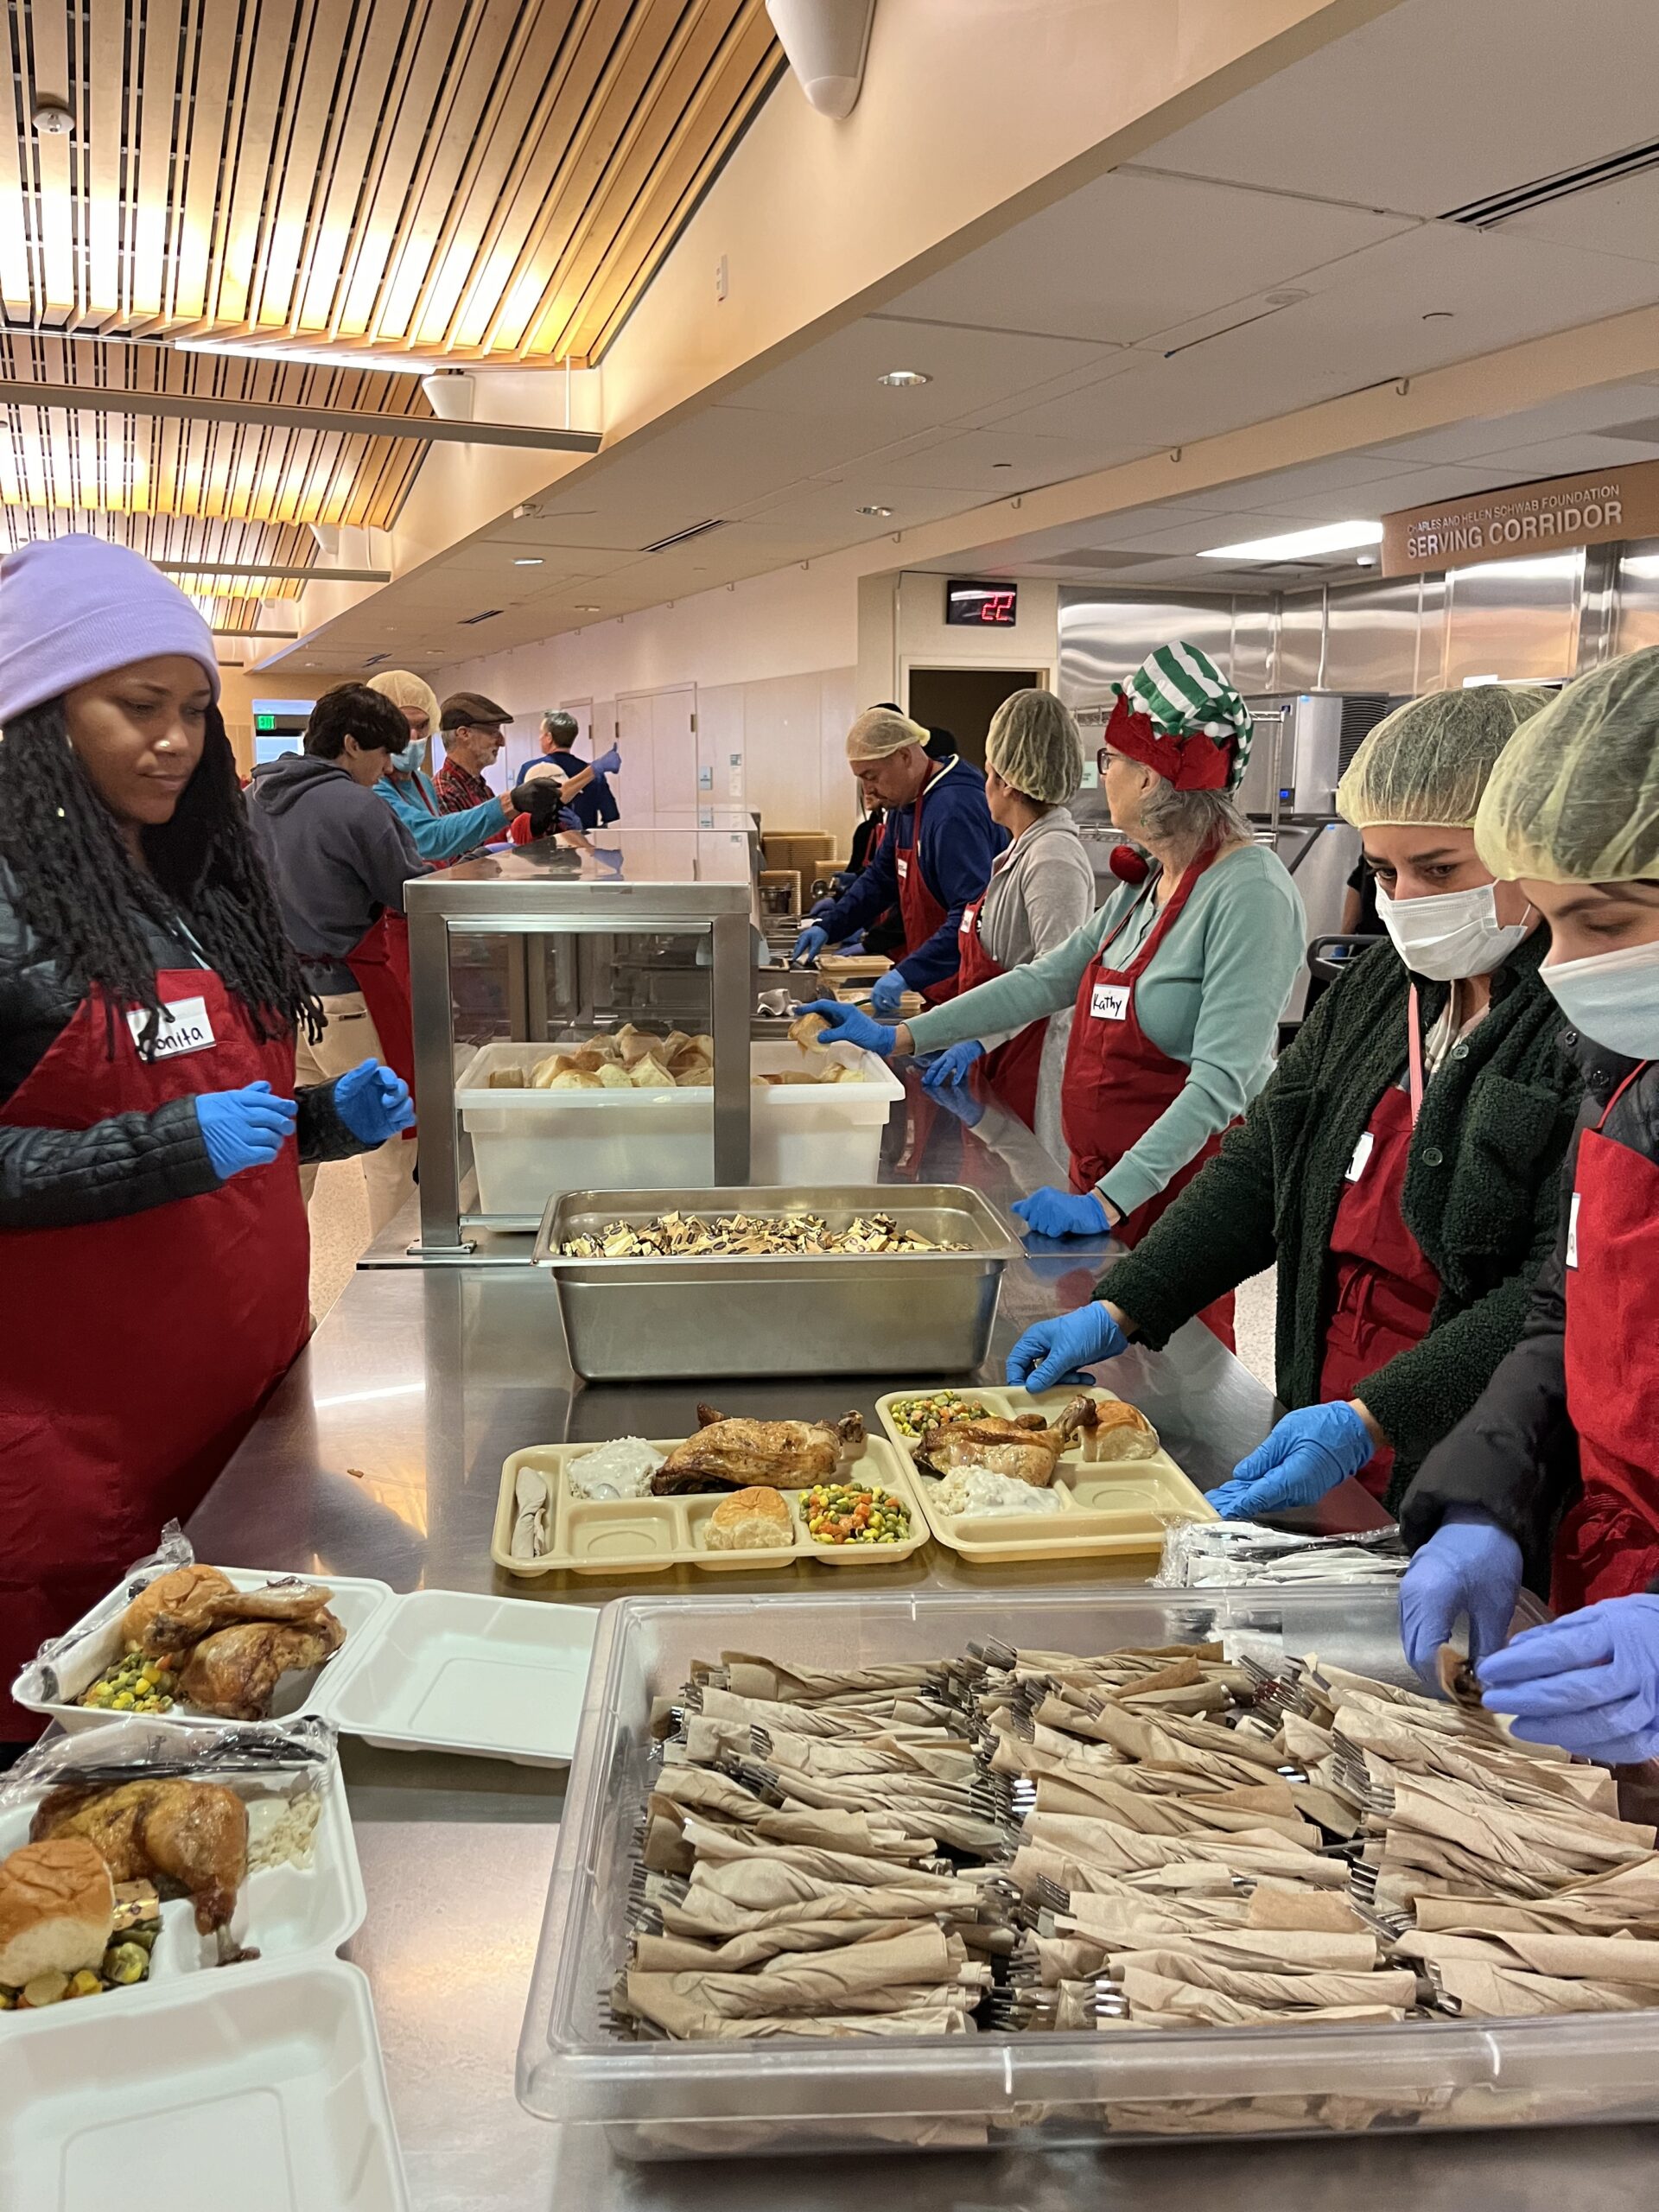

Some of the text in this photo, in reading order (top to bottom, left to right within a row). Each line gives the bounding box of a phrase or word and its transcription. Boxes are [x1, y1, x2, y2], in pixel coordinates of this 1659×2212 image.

[1407, 500, 1623, 560] SERVING CORRIDOR
[1408, 484, 1619, 535] CHARLES AND HELEN SCHWAB FOUNDATION
[981, 591, 1014, 621] 22
